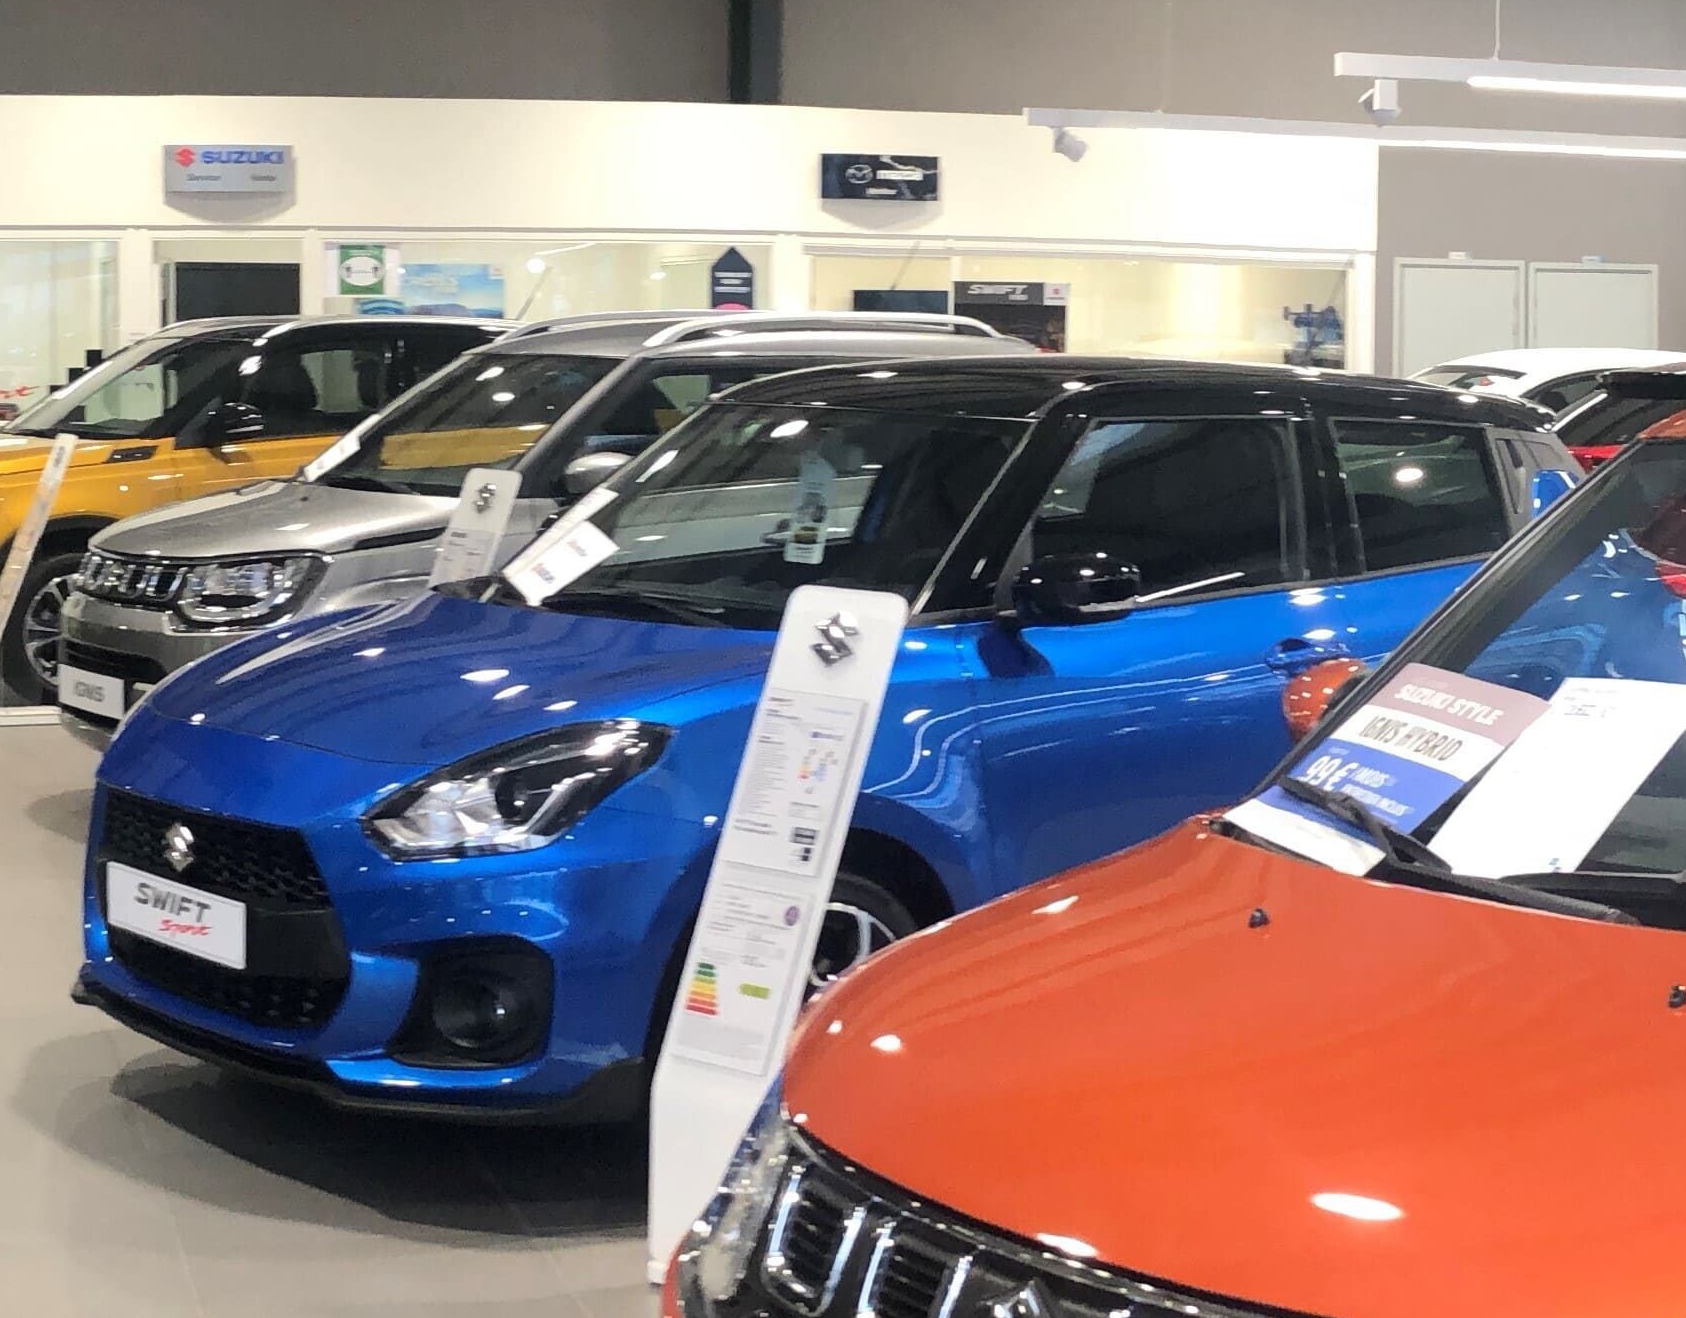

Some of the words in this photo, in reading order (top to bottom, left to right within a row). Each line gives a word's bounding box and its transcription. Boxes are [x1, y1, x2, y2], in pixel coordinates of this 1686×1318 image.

[201, 150, 285, 164] SUZUKI
[1394, 683, 1453, 711] SUZUKI
[1447, 697, 1504, 726] STYLE
[1395, 724, 1463, 761] HYBRID
[134, 882, 212, 923] SWIFT
[158, 919, 213, 939] Sport
